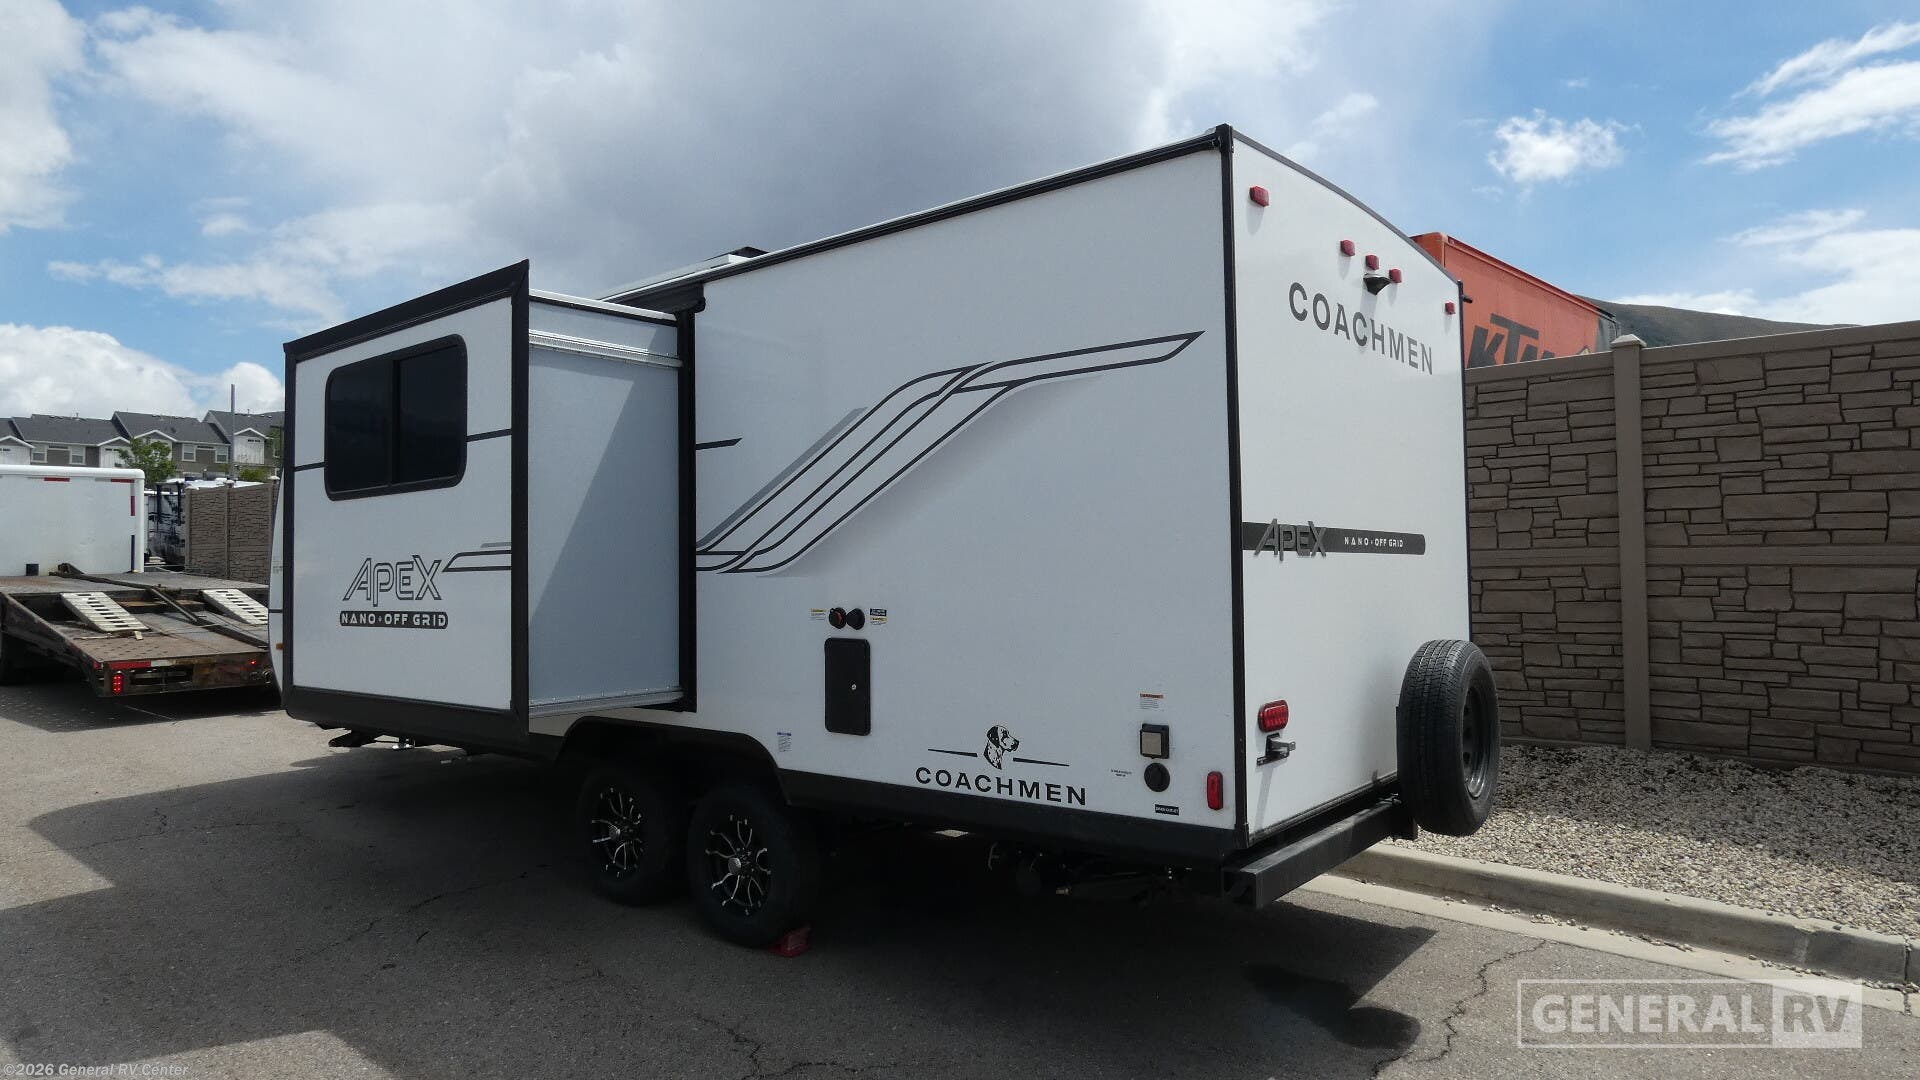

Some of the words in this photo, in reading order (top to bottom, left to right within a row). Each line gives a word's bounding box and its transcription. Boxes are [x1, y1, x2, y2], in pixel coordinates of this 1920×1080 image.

[1288, 281, 1433, 375] COACHMEN
[1467, 312, 1556, 369] KT
[1253, 517, 1327, 561] APEX
[1388, 538, 1404, 548] GRID
[342, 554, 443, 607] APEX
[412, 614, 447, 627] GRID
[915, 766, 1086, 806] COACHMEN
